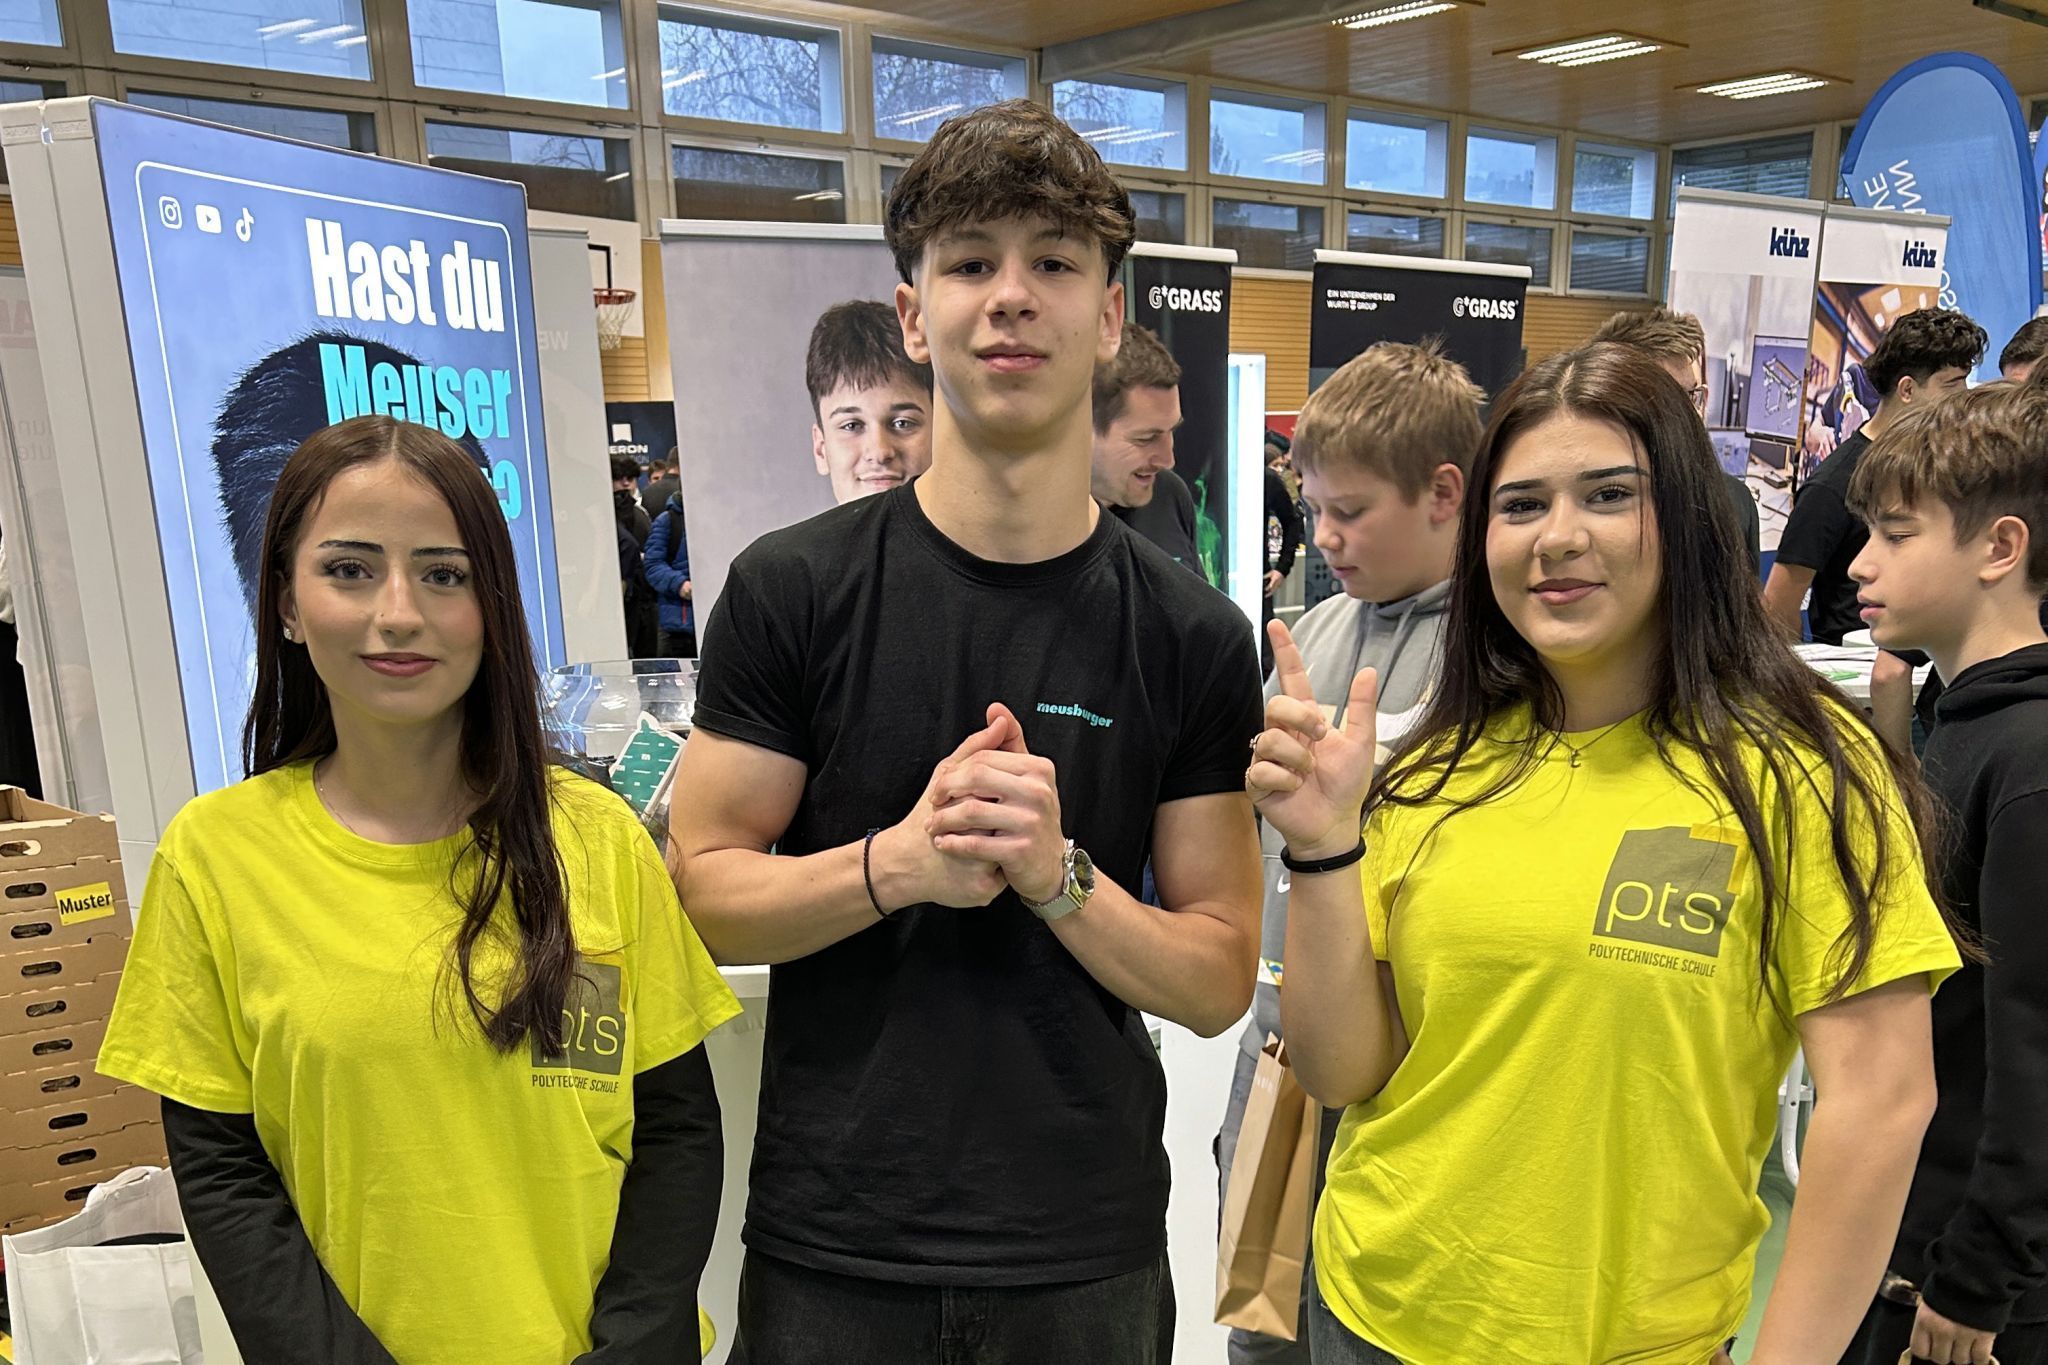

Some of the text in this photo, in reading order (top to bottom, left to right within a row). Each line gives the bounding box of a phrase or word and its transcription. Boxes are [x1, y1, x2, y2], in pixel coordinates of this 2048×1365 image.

[305, 217, 505, 332] Hast du
[318, 342, 512, 440] Meuser
[1036, 702, 1113, 728] meusburger
[59, 893, 111, 915] Muster
[1605, 881, 1722, 935] pts
[1589, 943, 1717, 978] POLYTECHNISCHE SCHULE
[589, 1079, 619, 1094] SCHULE
